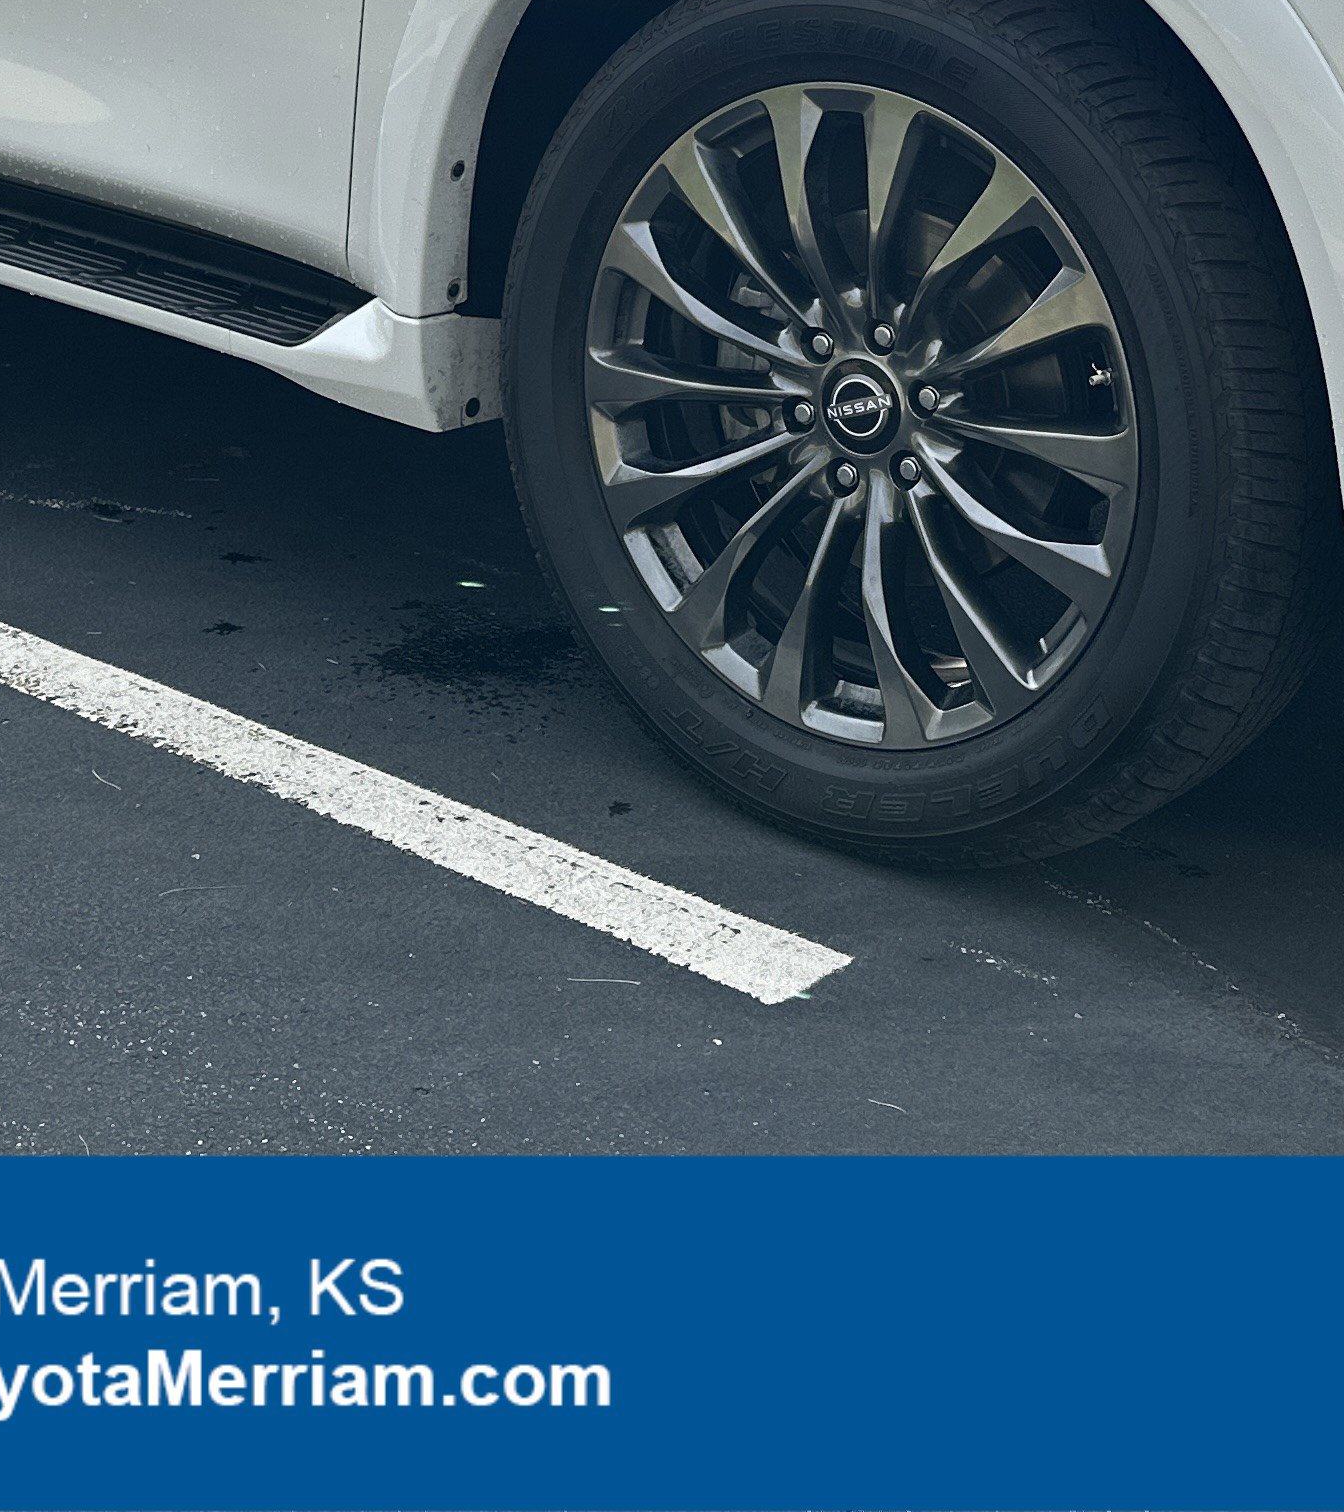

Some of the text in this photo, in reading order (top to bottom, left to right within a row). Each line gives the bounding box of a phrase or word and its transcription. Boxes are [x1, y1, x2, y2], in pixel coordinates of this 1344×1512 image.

[602, 16, 978, 149] BRIDGESTONE
[827, 394, 891, 419] NISSAN
[820, 693, 1114, 824] DUELER
